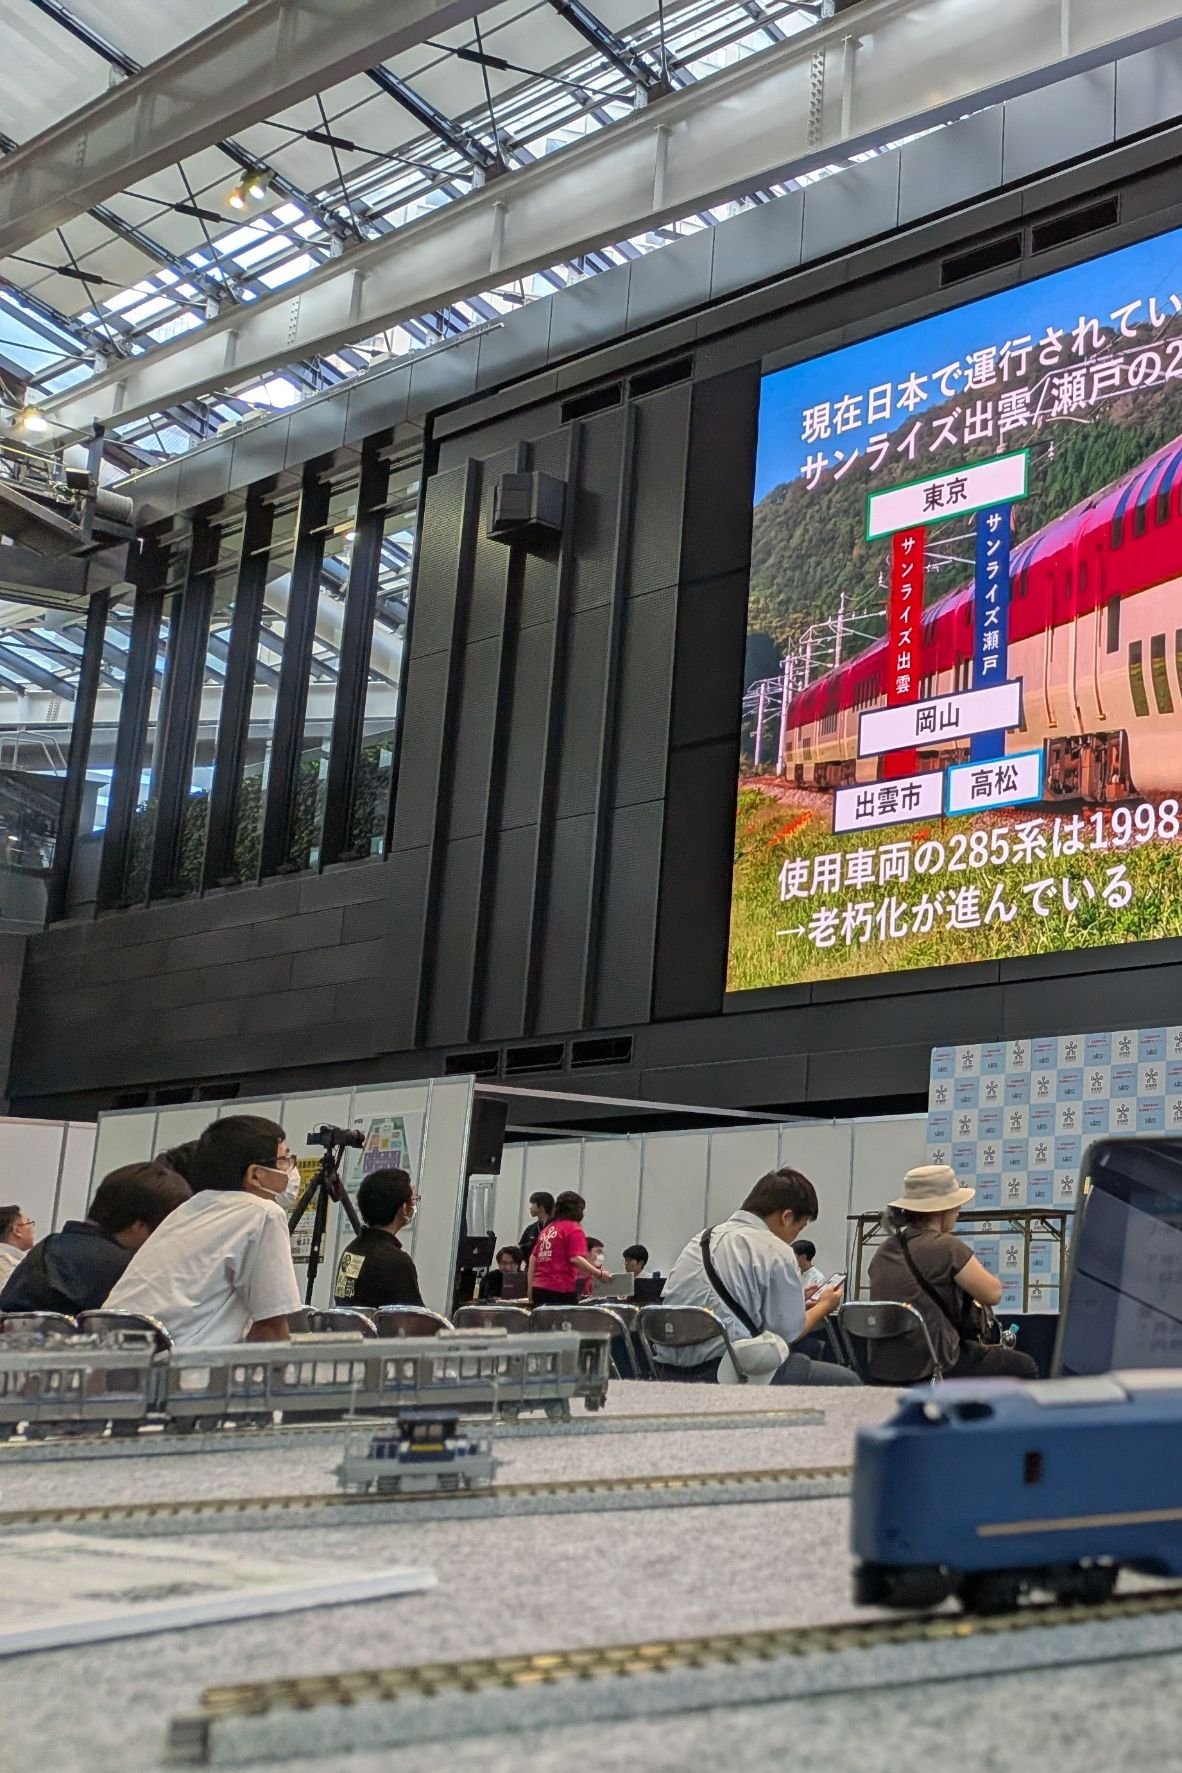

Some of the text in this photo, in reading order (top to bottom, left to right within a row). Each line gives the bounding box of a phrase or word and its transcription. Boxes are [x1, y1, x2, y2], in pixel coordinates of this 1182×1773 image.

[923, 477, 967, 512] 東京
[982, 513, 1001, 676] サンライズ瀬戸
[895, 537, 915, 694] サンライズ出雲
[916, 702, 960, 736] 岡山
[970, 764, 1018, 800] 高松
[855, 782, 922, 820] 出雲市
